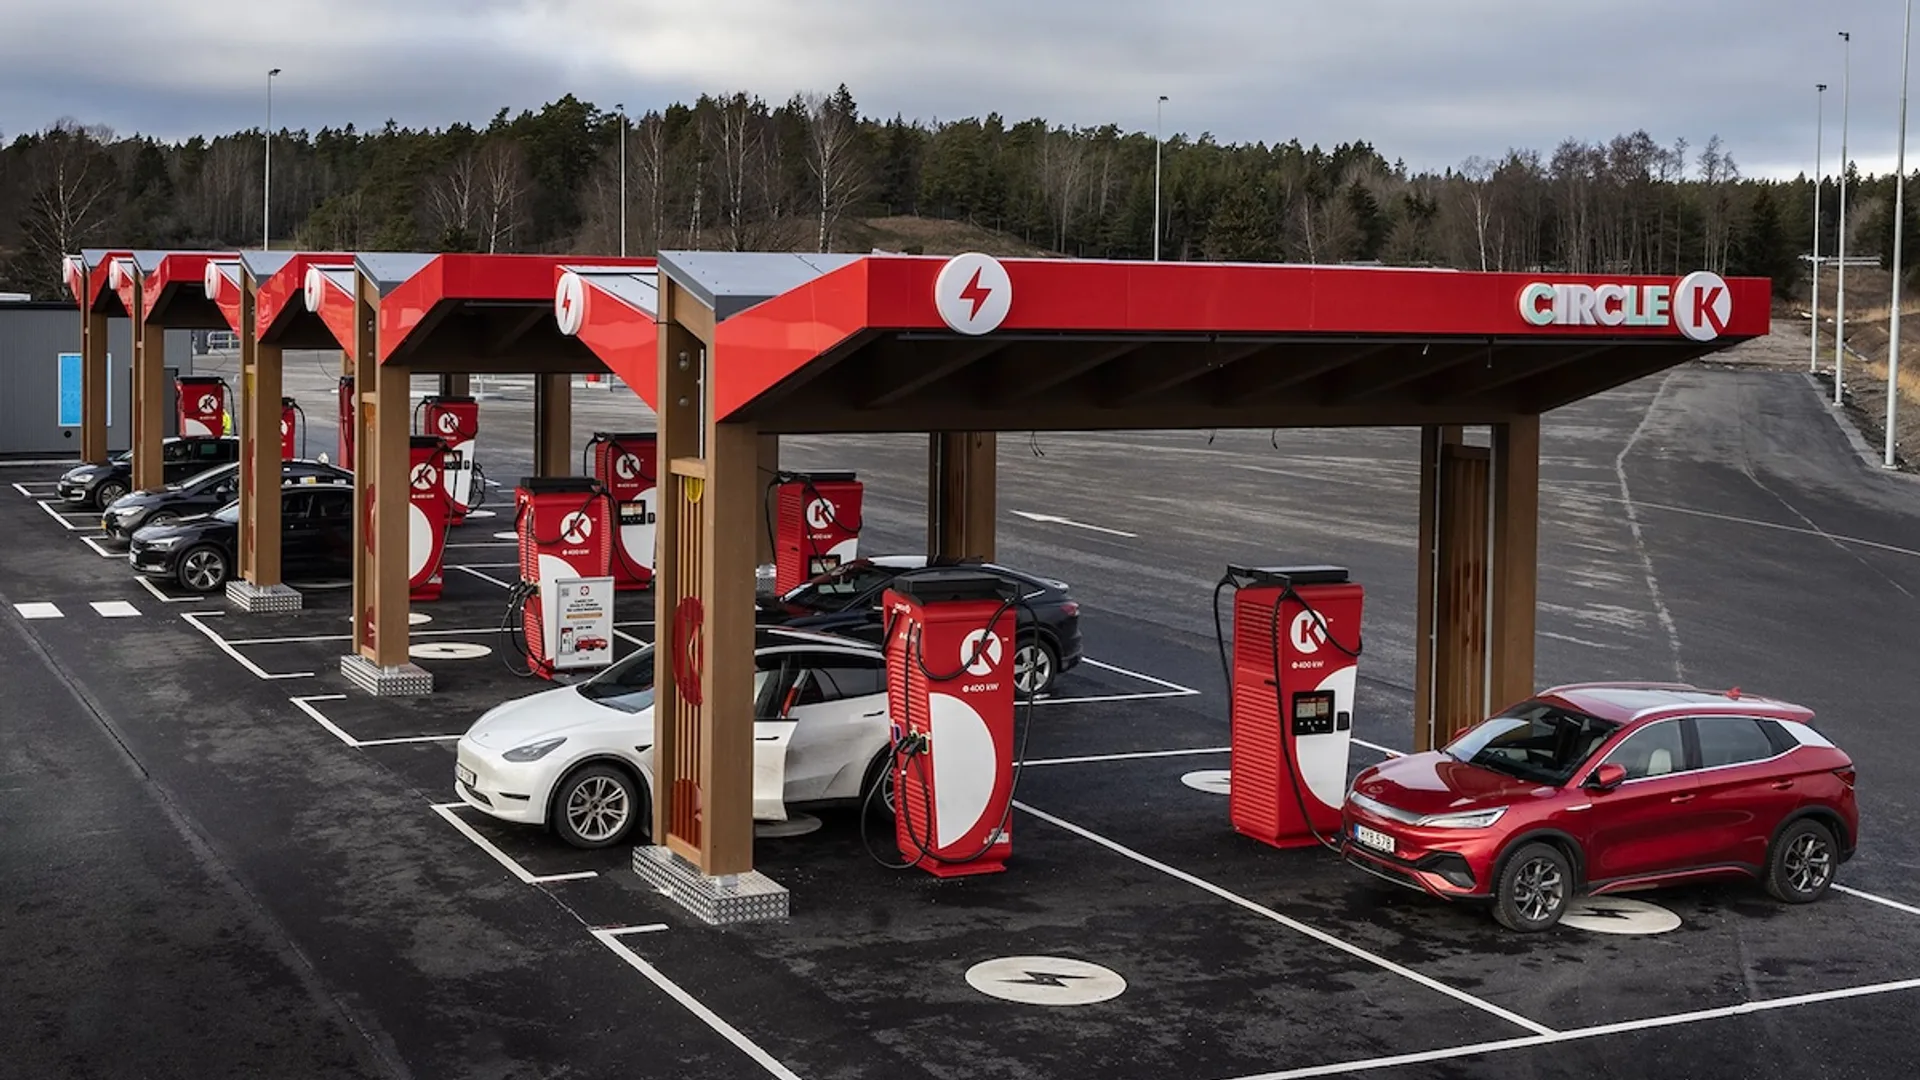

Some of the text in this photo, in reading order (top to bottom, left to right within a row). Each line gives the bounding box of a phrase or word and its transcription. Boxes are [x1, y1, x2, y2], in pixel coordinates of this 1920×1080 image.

[1520, 282, 1670, 326] CIRCLE
[1299, 661, 1312, 669] 400
[970, 683, 1000, 692] 400 kW
